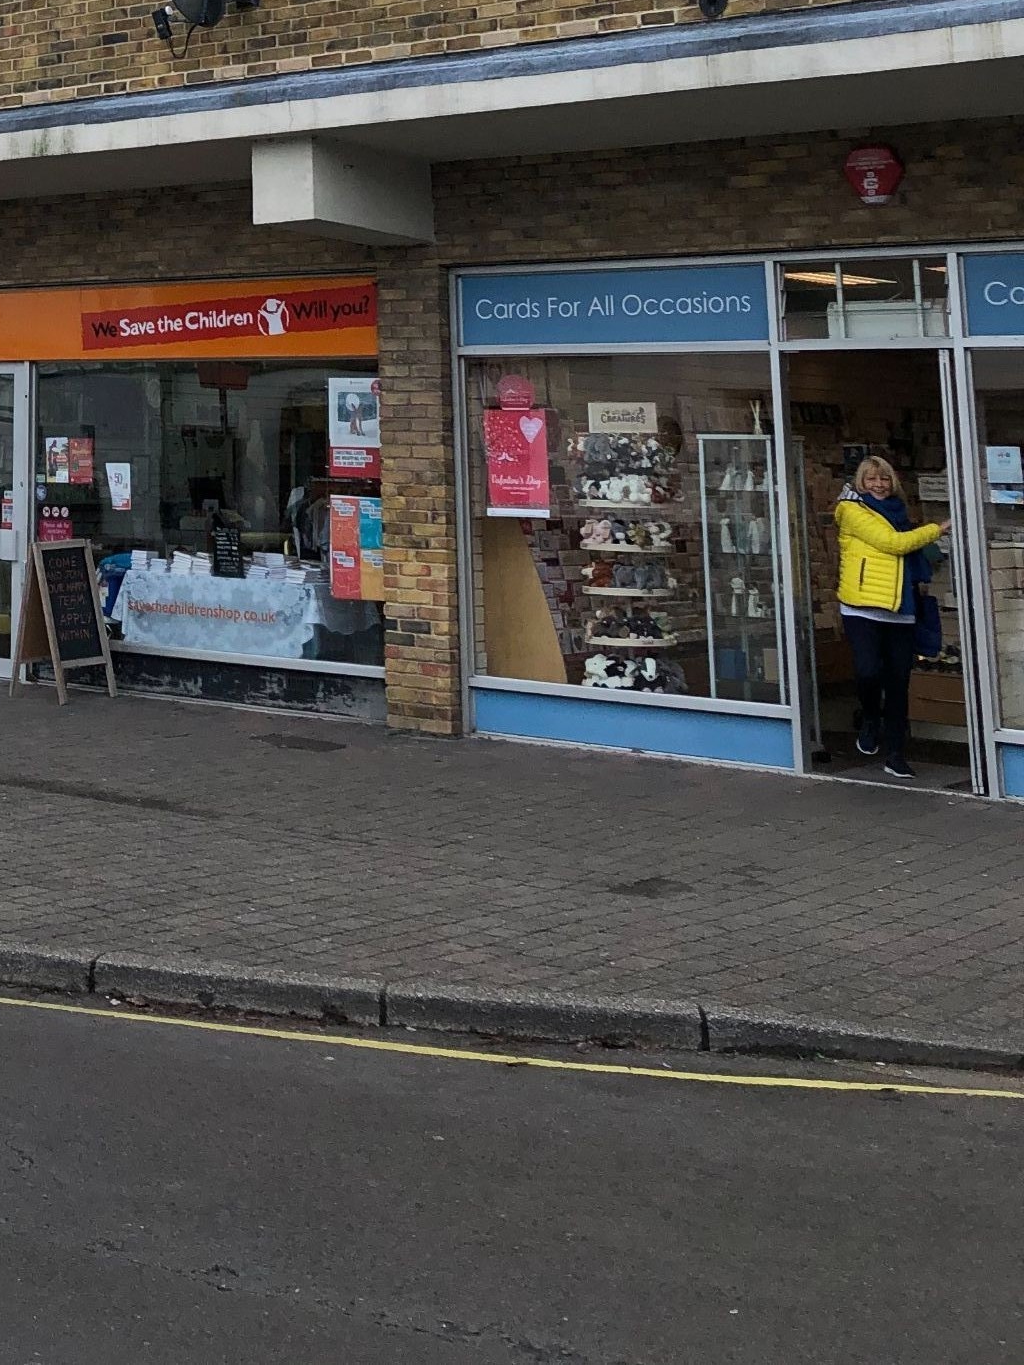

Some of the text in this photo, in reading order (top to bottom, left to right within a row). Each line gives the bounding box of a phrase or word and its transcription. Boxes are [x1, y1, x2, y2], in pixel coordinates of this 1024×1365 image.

[475, 291, 752, 320] Cards For All Occasions
[91, 295, 370, 338] We Save the Children Will you?
[491, 474, 542, 489] Valentine's Day
[48, 555, 77, 569] COME
[60, 611, 92, 626] APPLY
[127, 598, 277, 624] savethechildrenshop.co.uk
